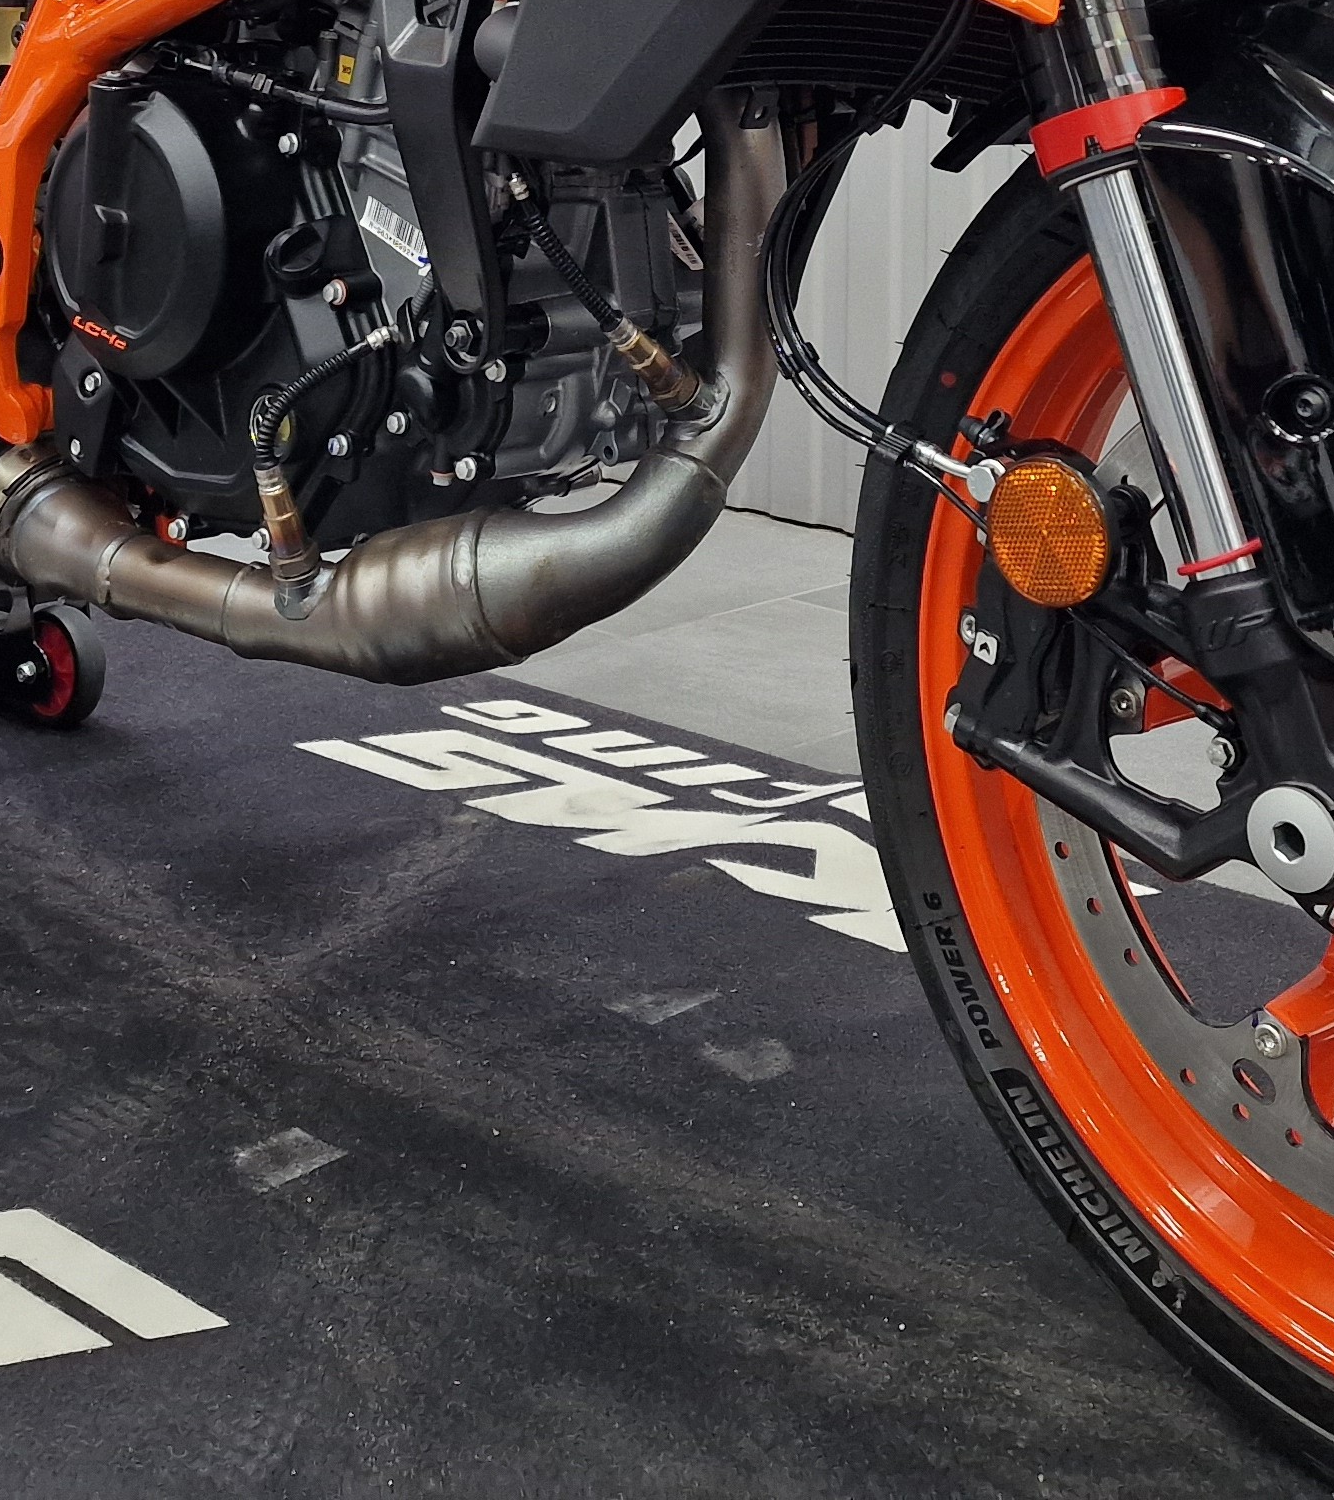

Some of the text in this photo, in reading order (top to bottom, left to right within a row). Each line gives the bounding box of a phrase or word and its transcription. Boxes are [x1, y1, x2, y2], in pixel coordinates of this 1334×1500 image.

[922, 890, 1003, 1050] POWER 6
[1007, 1085, 1152, 1264] MICHELIN
